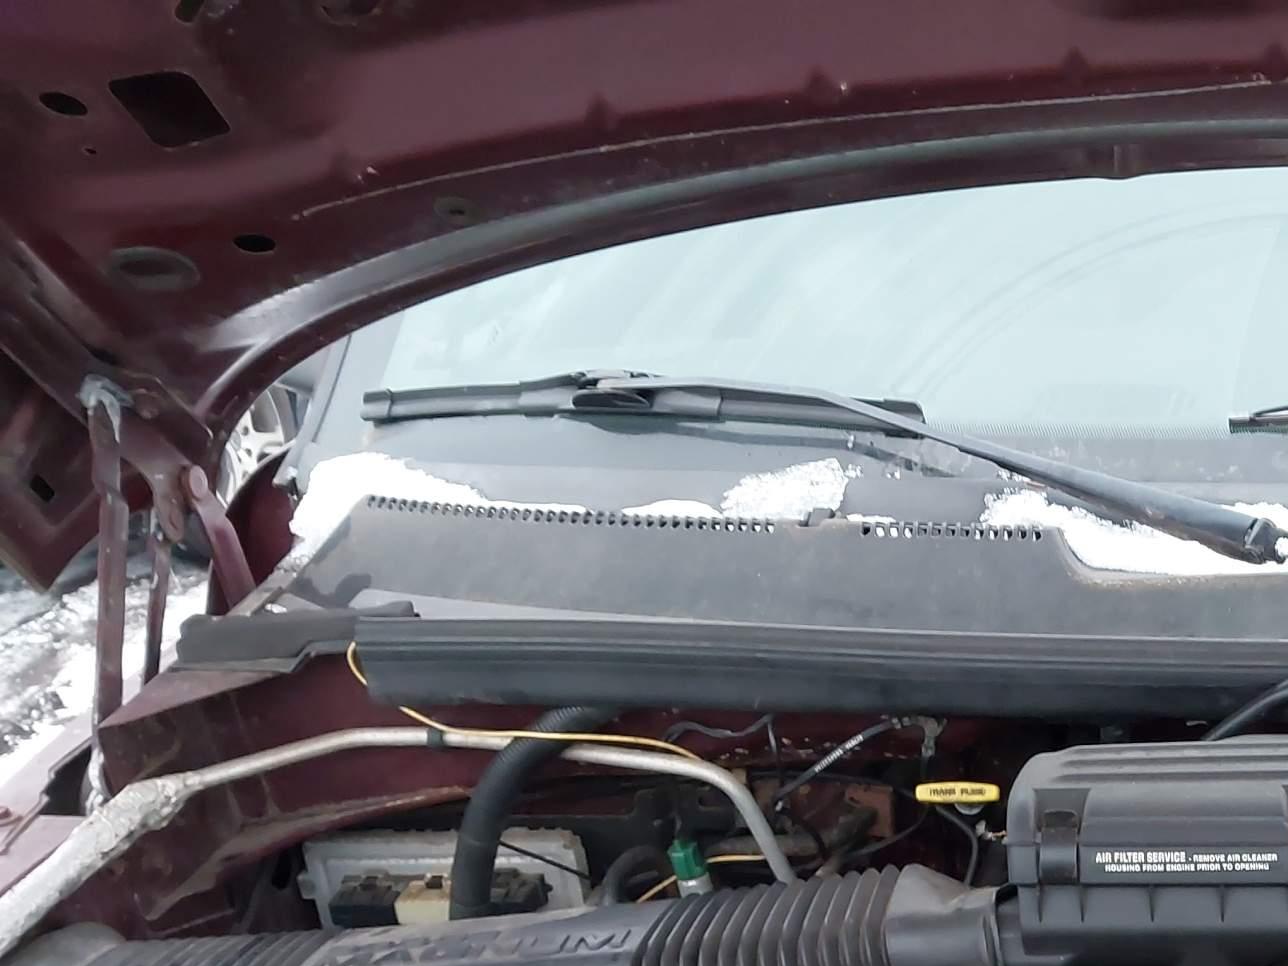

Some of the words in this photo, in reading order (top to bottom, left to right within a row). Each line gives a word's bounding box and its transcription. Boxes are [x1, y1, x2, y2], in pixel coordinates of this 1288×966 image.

[1096, 852, 1112, 863] AIR
[1114, 852, 1145, 863] FILTER
[1147, 851, 1186, 863] SERVICE
[1193, 854, 1226, 862] REMOVE
[1227, 854, 1241, 862] AIR
[1242, 853, 1278, 862] CLEANER
[1105, 864, 1141, 872] HOUSING
[1142, 864, 1165, 872] FROM
[1166, 864, 1195, 872] ENGINE
[1197, 864, 1221, 872] PRIOR
[1222, 863, 1233, 871] TO
[1235, 863, 1270, 871] OPENING
